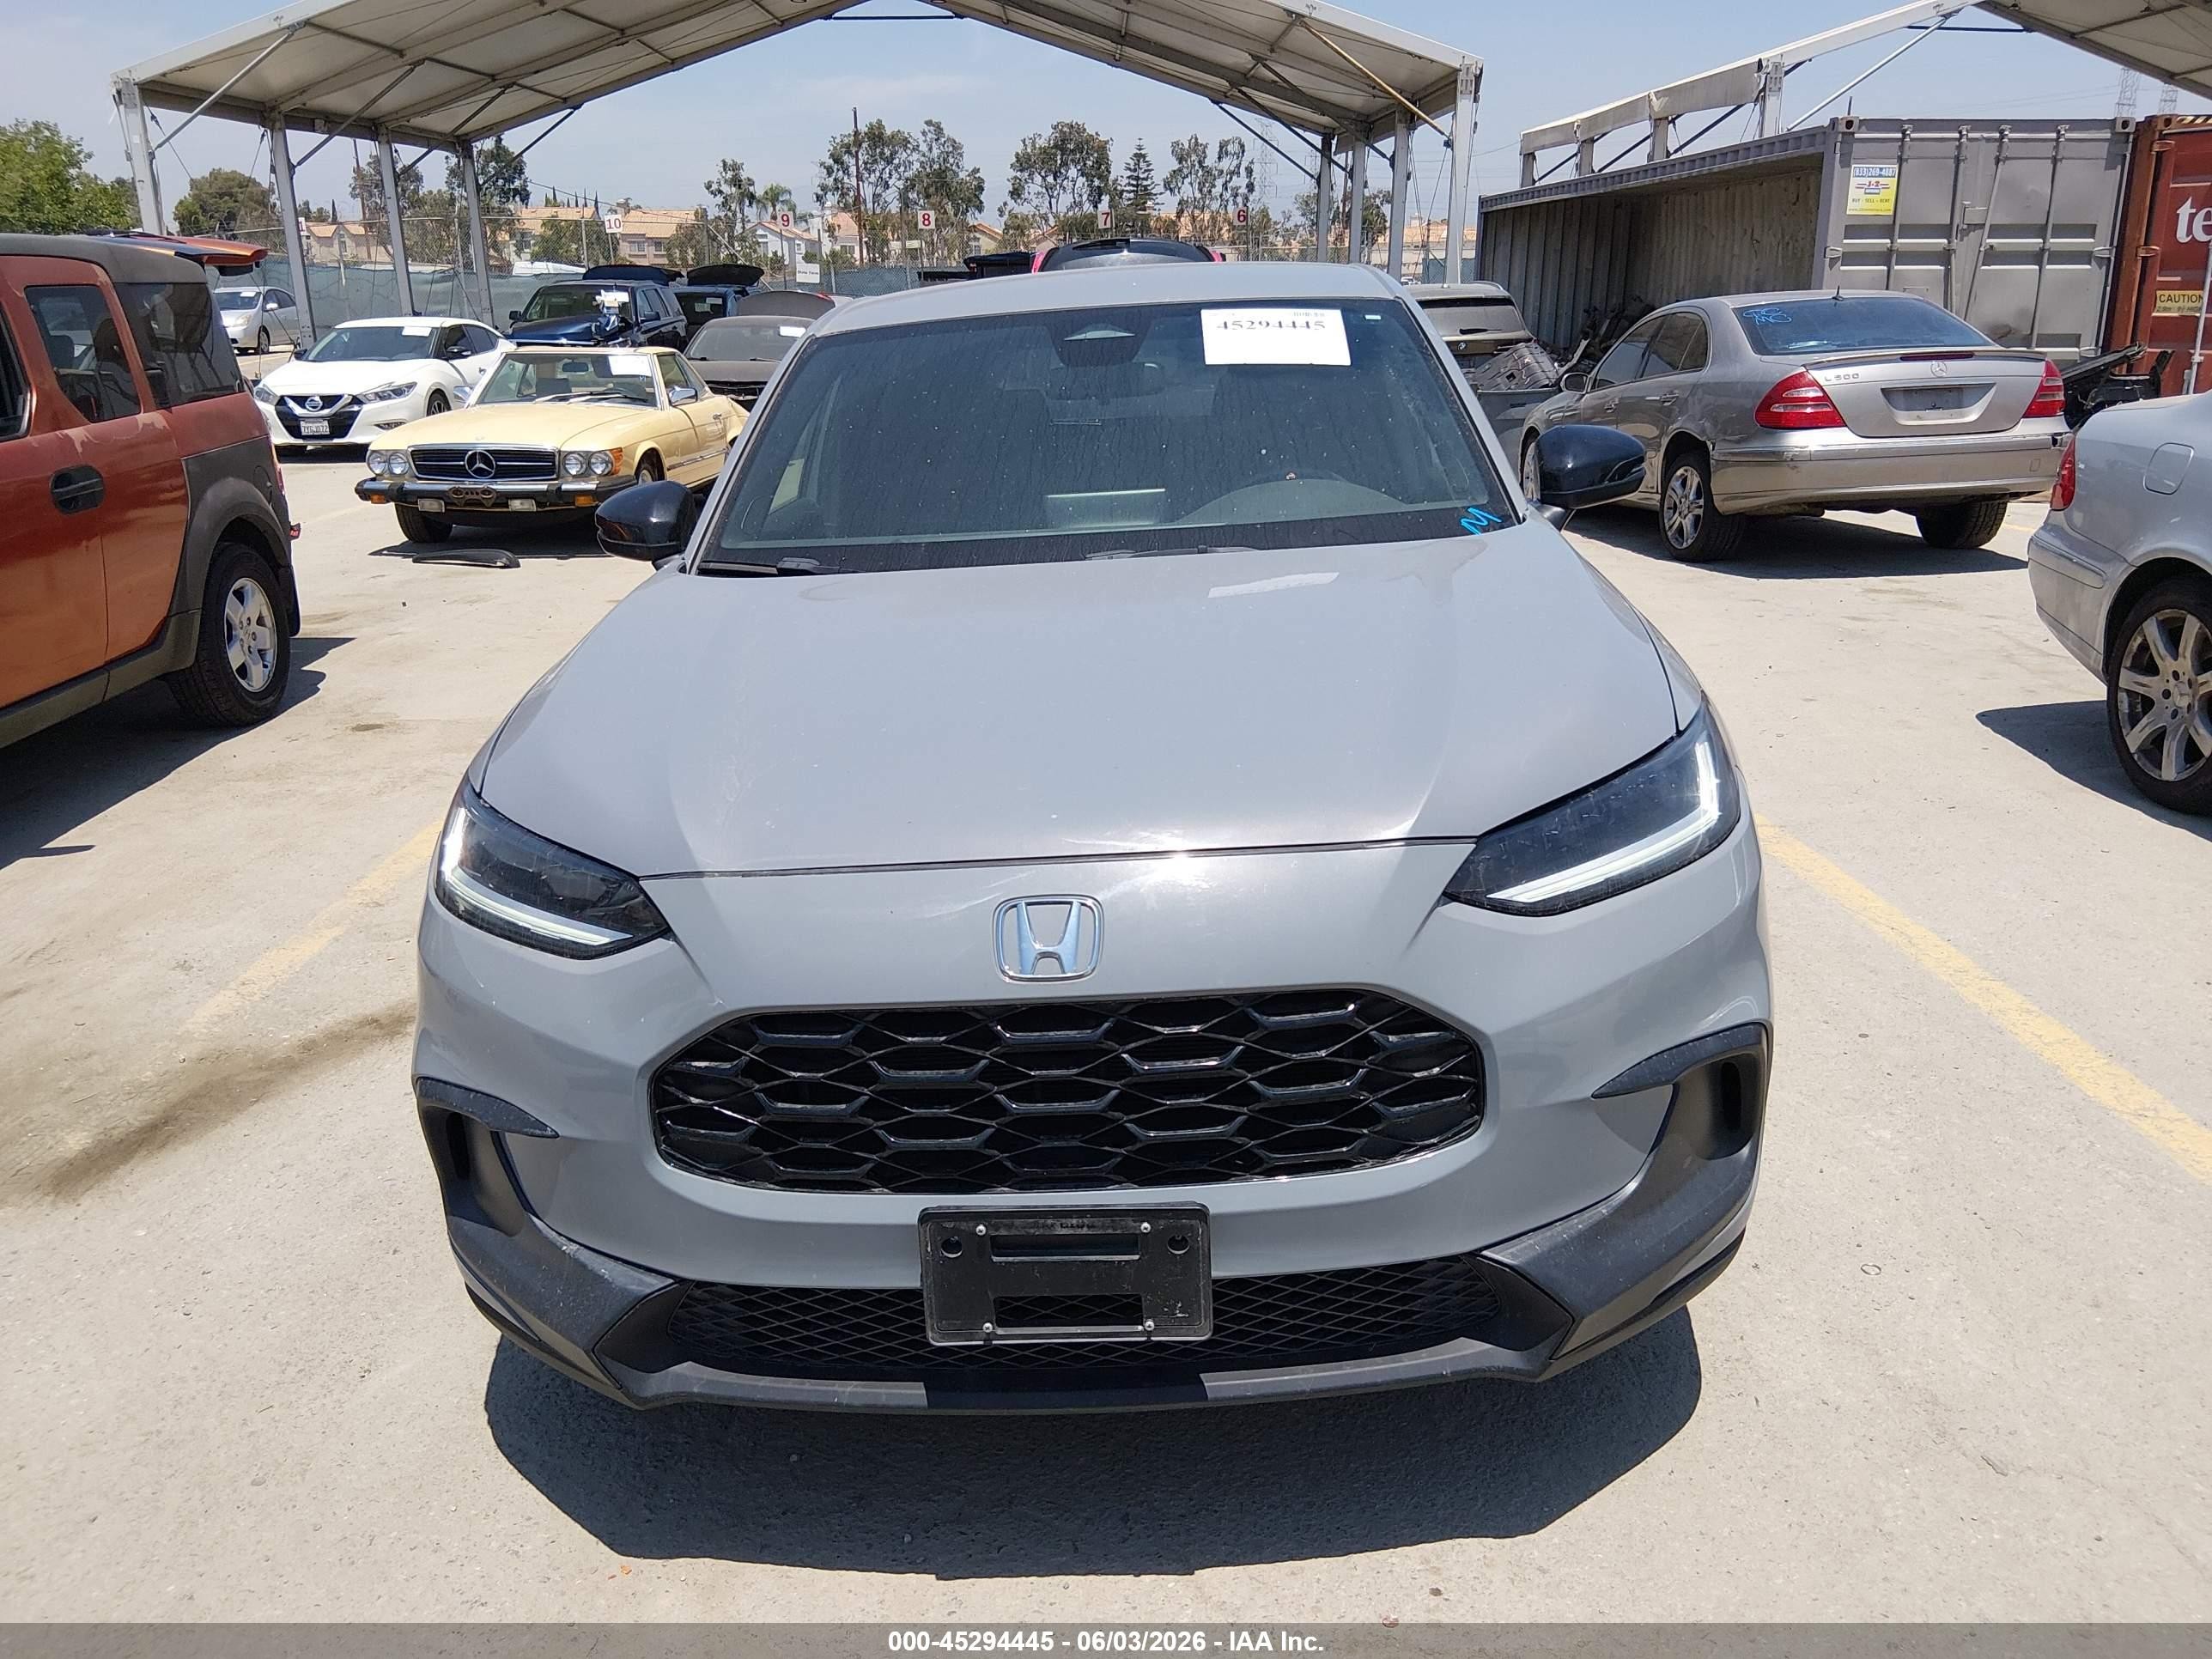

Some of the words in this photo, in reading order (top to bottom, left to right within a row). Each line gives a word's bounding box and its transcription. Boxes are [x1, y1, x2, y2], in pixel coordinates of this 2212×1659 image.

[781, 213, 790, 227] 9
[922, 213, 931, 226] 8
[1102, 212, 1109, 226] 7
[1237, 210, 1246, 222] 6
[606, 217, 622, 230] 10
[1217, 320, 1325, 330] 45294445
